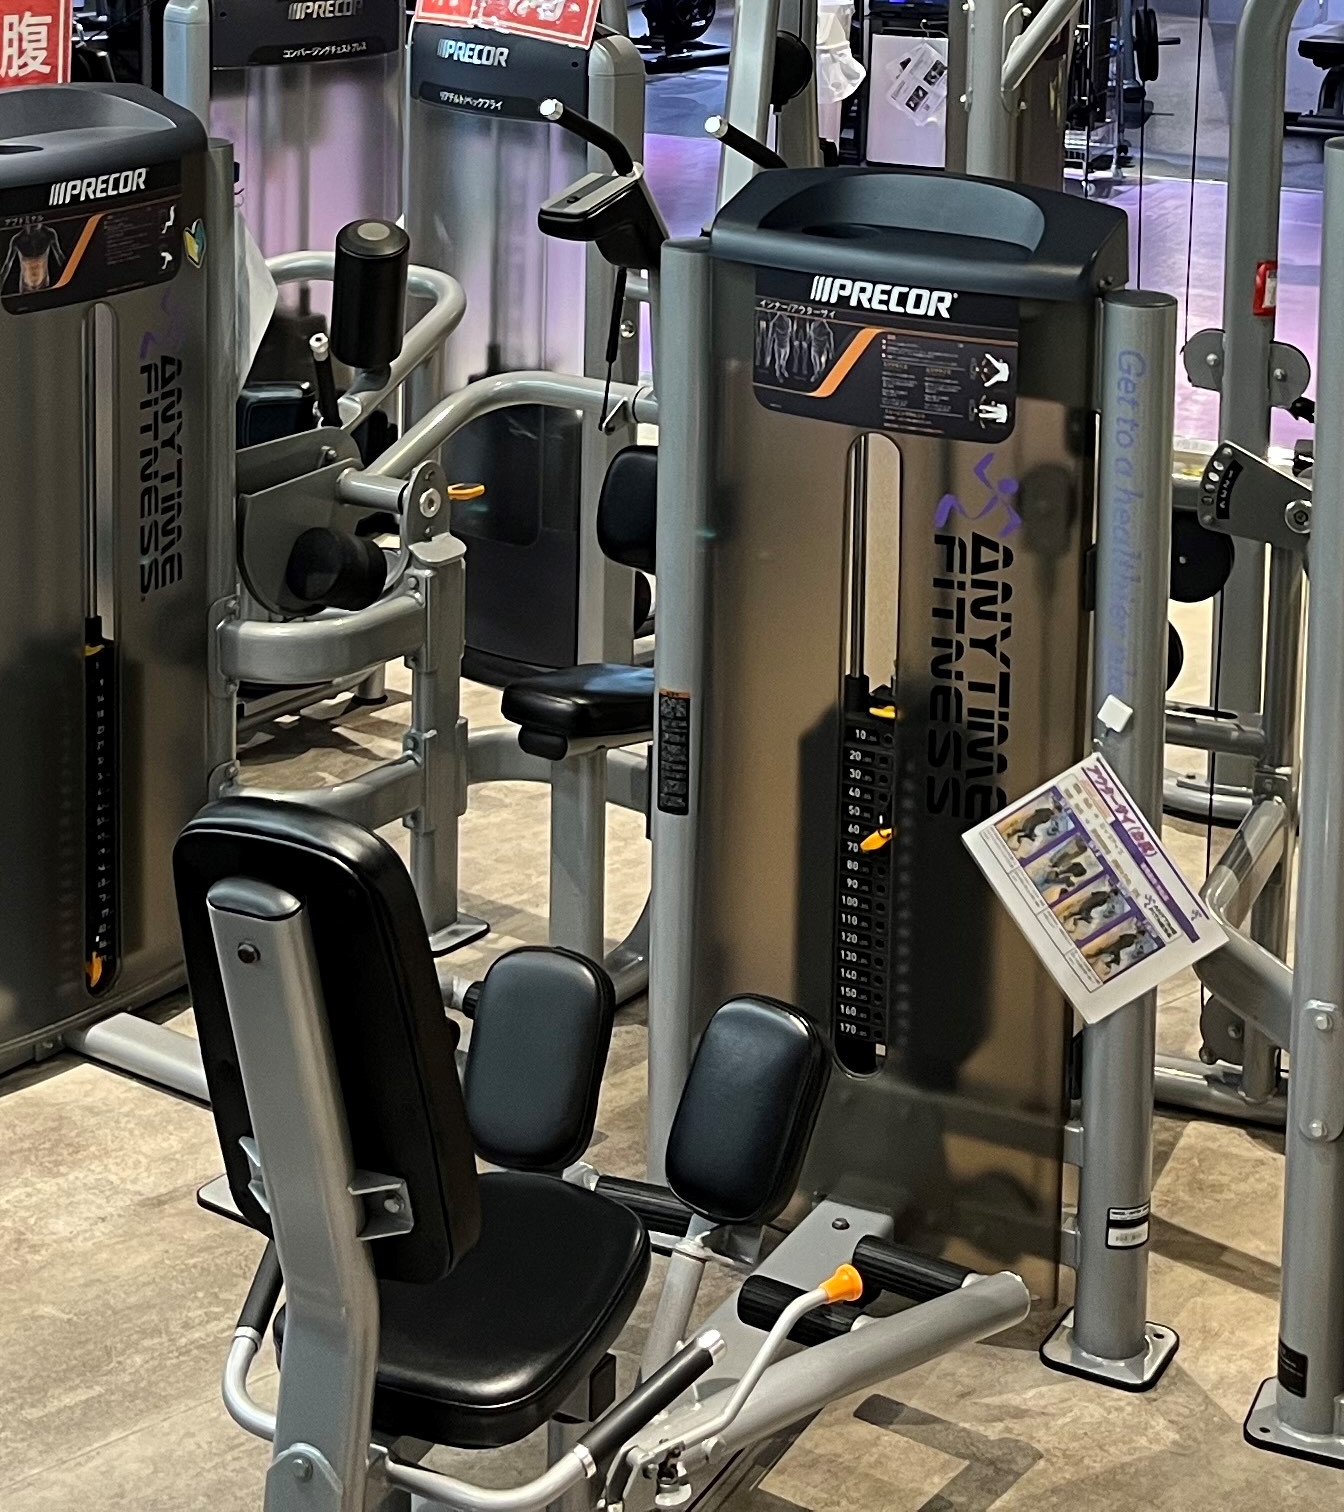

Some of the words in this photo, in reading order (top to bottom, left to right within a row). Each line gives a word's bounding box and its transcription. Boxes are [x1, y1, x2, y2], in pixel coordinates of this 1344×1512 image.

[445, 40, 509, 67] PRECOR
[65, 167, 147, 204] PRECOR
[830, 278, 953, 318] PRECOR
[1116, 350, 1147, 409] Get
[1116, 416, 1140, 450] to
[160, 355, 183, 591] ANYTIME
[1115, 458, 1134, 478] a
[139, 362, 159, 595] FITNESS
[926, 533, 967, 818] FITNESS
[964, 531, 1014, 820] ANYTIME
[855, 729, 867, 740] 10
[849, 750, 862, 761] 20
[849, 768, 862, 780] 30
[848, 787, 861, 798] 40
[848, 805, 861, 816] 50
[848, 823, 860, 834] 60
[847, 841, 859, 853] 70
[846, 859, 859, 871] 80
[846, 878, 858, 889] 90
[841, 895, 859, 907] 100
[841, 913, 858, 926] 110
[841, 931, 858, 944] 120
[840, 949, 857, 962] 130
[840, 968, 857, 980] 140
[840, 986, 857, 998] 150
[839, 1004, 857, 1017] 160
[839, 1022, 857, 1035] 170
